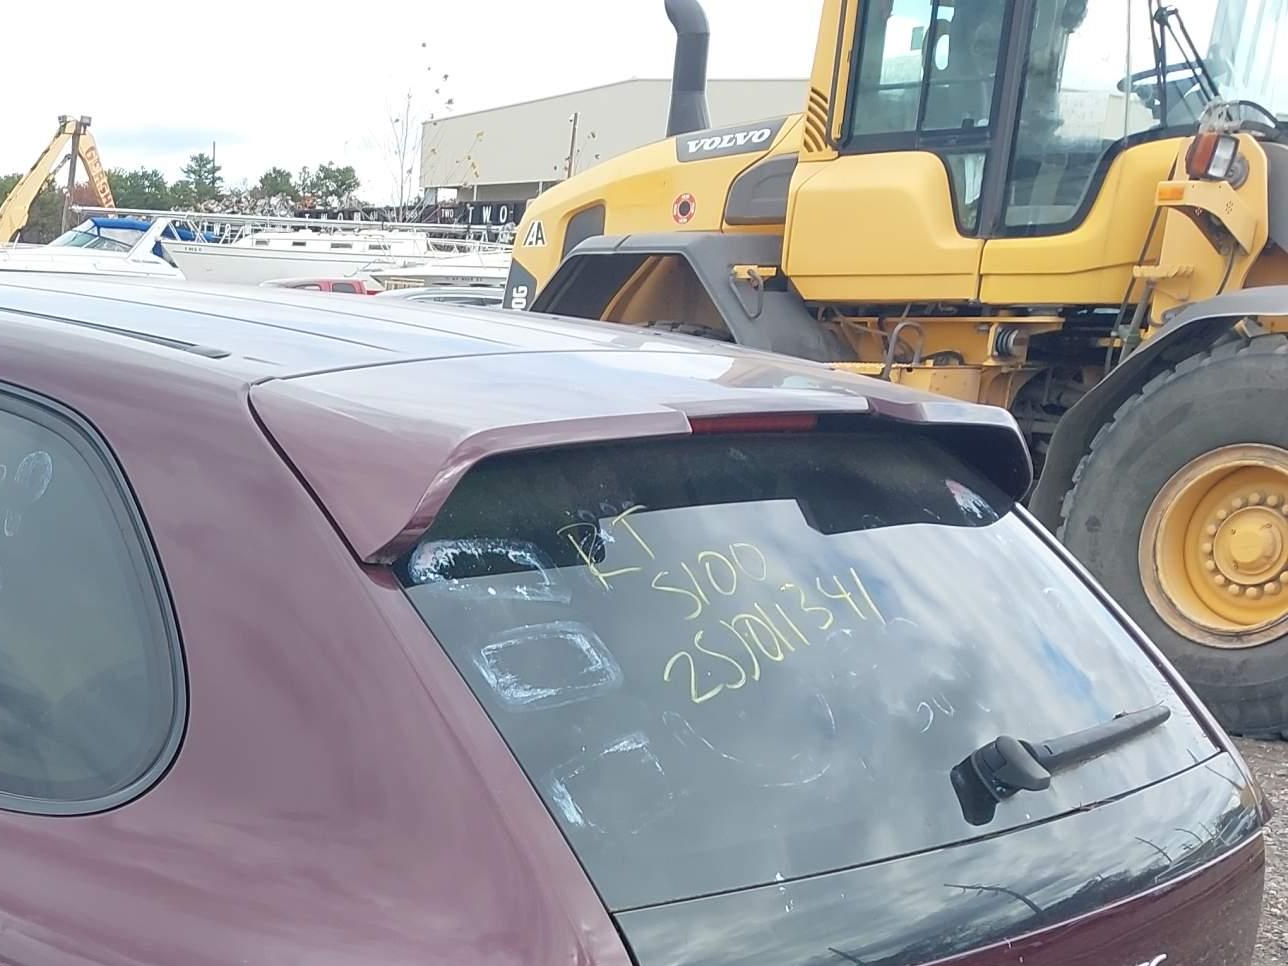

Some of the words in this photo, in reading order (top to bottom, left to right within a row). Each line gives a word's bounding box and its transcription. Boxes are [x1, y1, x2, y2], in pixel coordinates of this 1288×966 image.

[686, 128, 771, 153] VOLVO
[467, 205, 508, 223] TWO
[556, 504, 655, 592] RT
